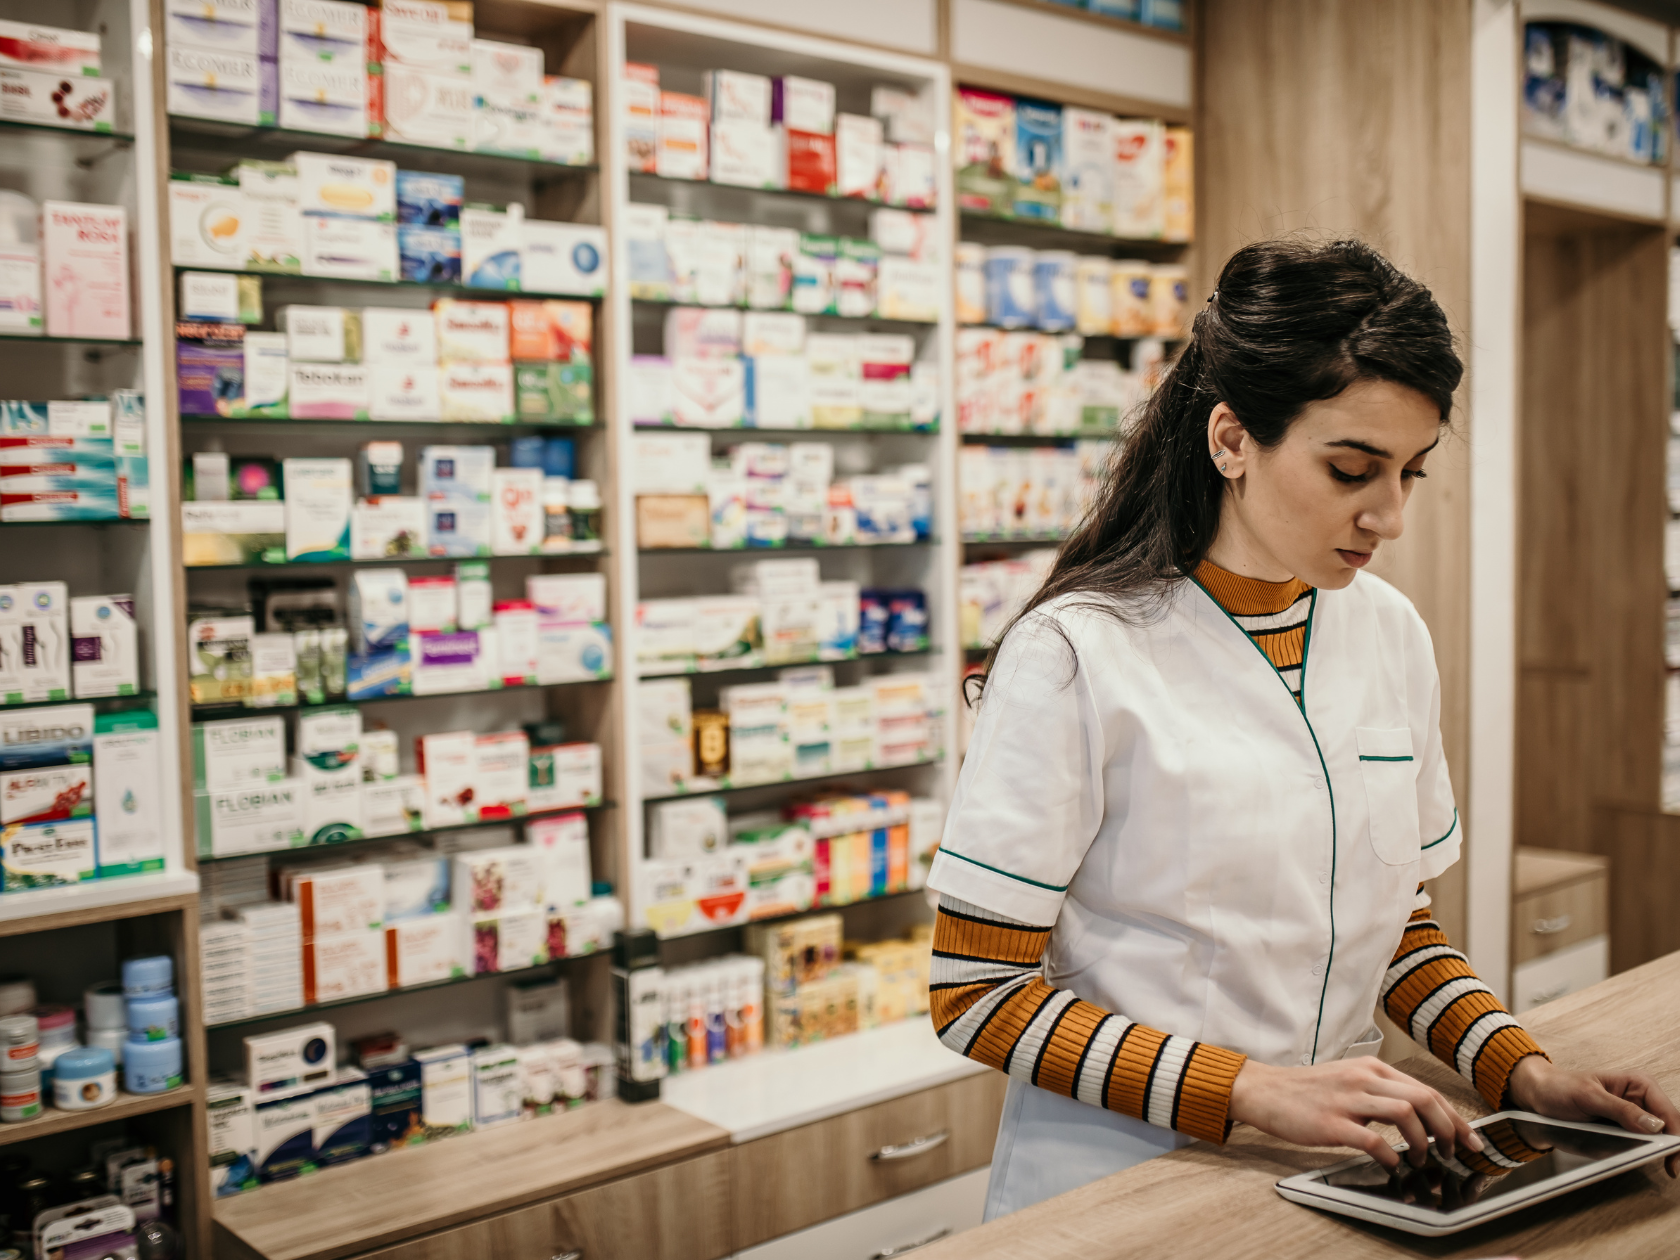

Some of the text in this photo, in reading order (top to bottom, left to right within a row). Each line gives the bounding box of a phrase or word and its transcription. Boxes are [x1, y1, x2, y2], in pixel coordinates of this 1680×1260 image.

[284, 2, 362, 25] ECOMER
[171, 51, 255, 77] ECOMER
[294, 369, 363, 387] Tebokan
[3, 725, 85, 745] LIBIDO
